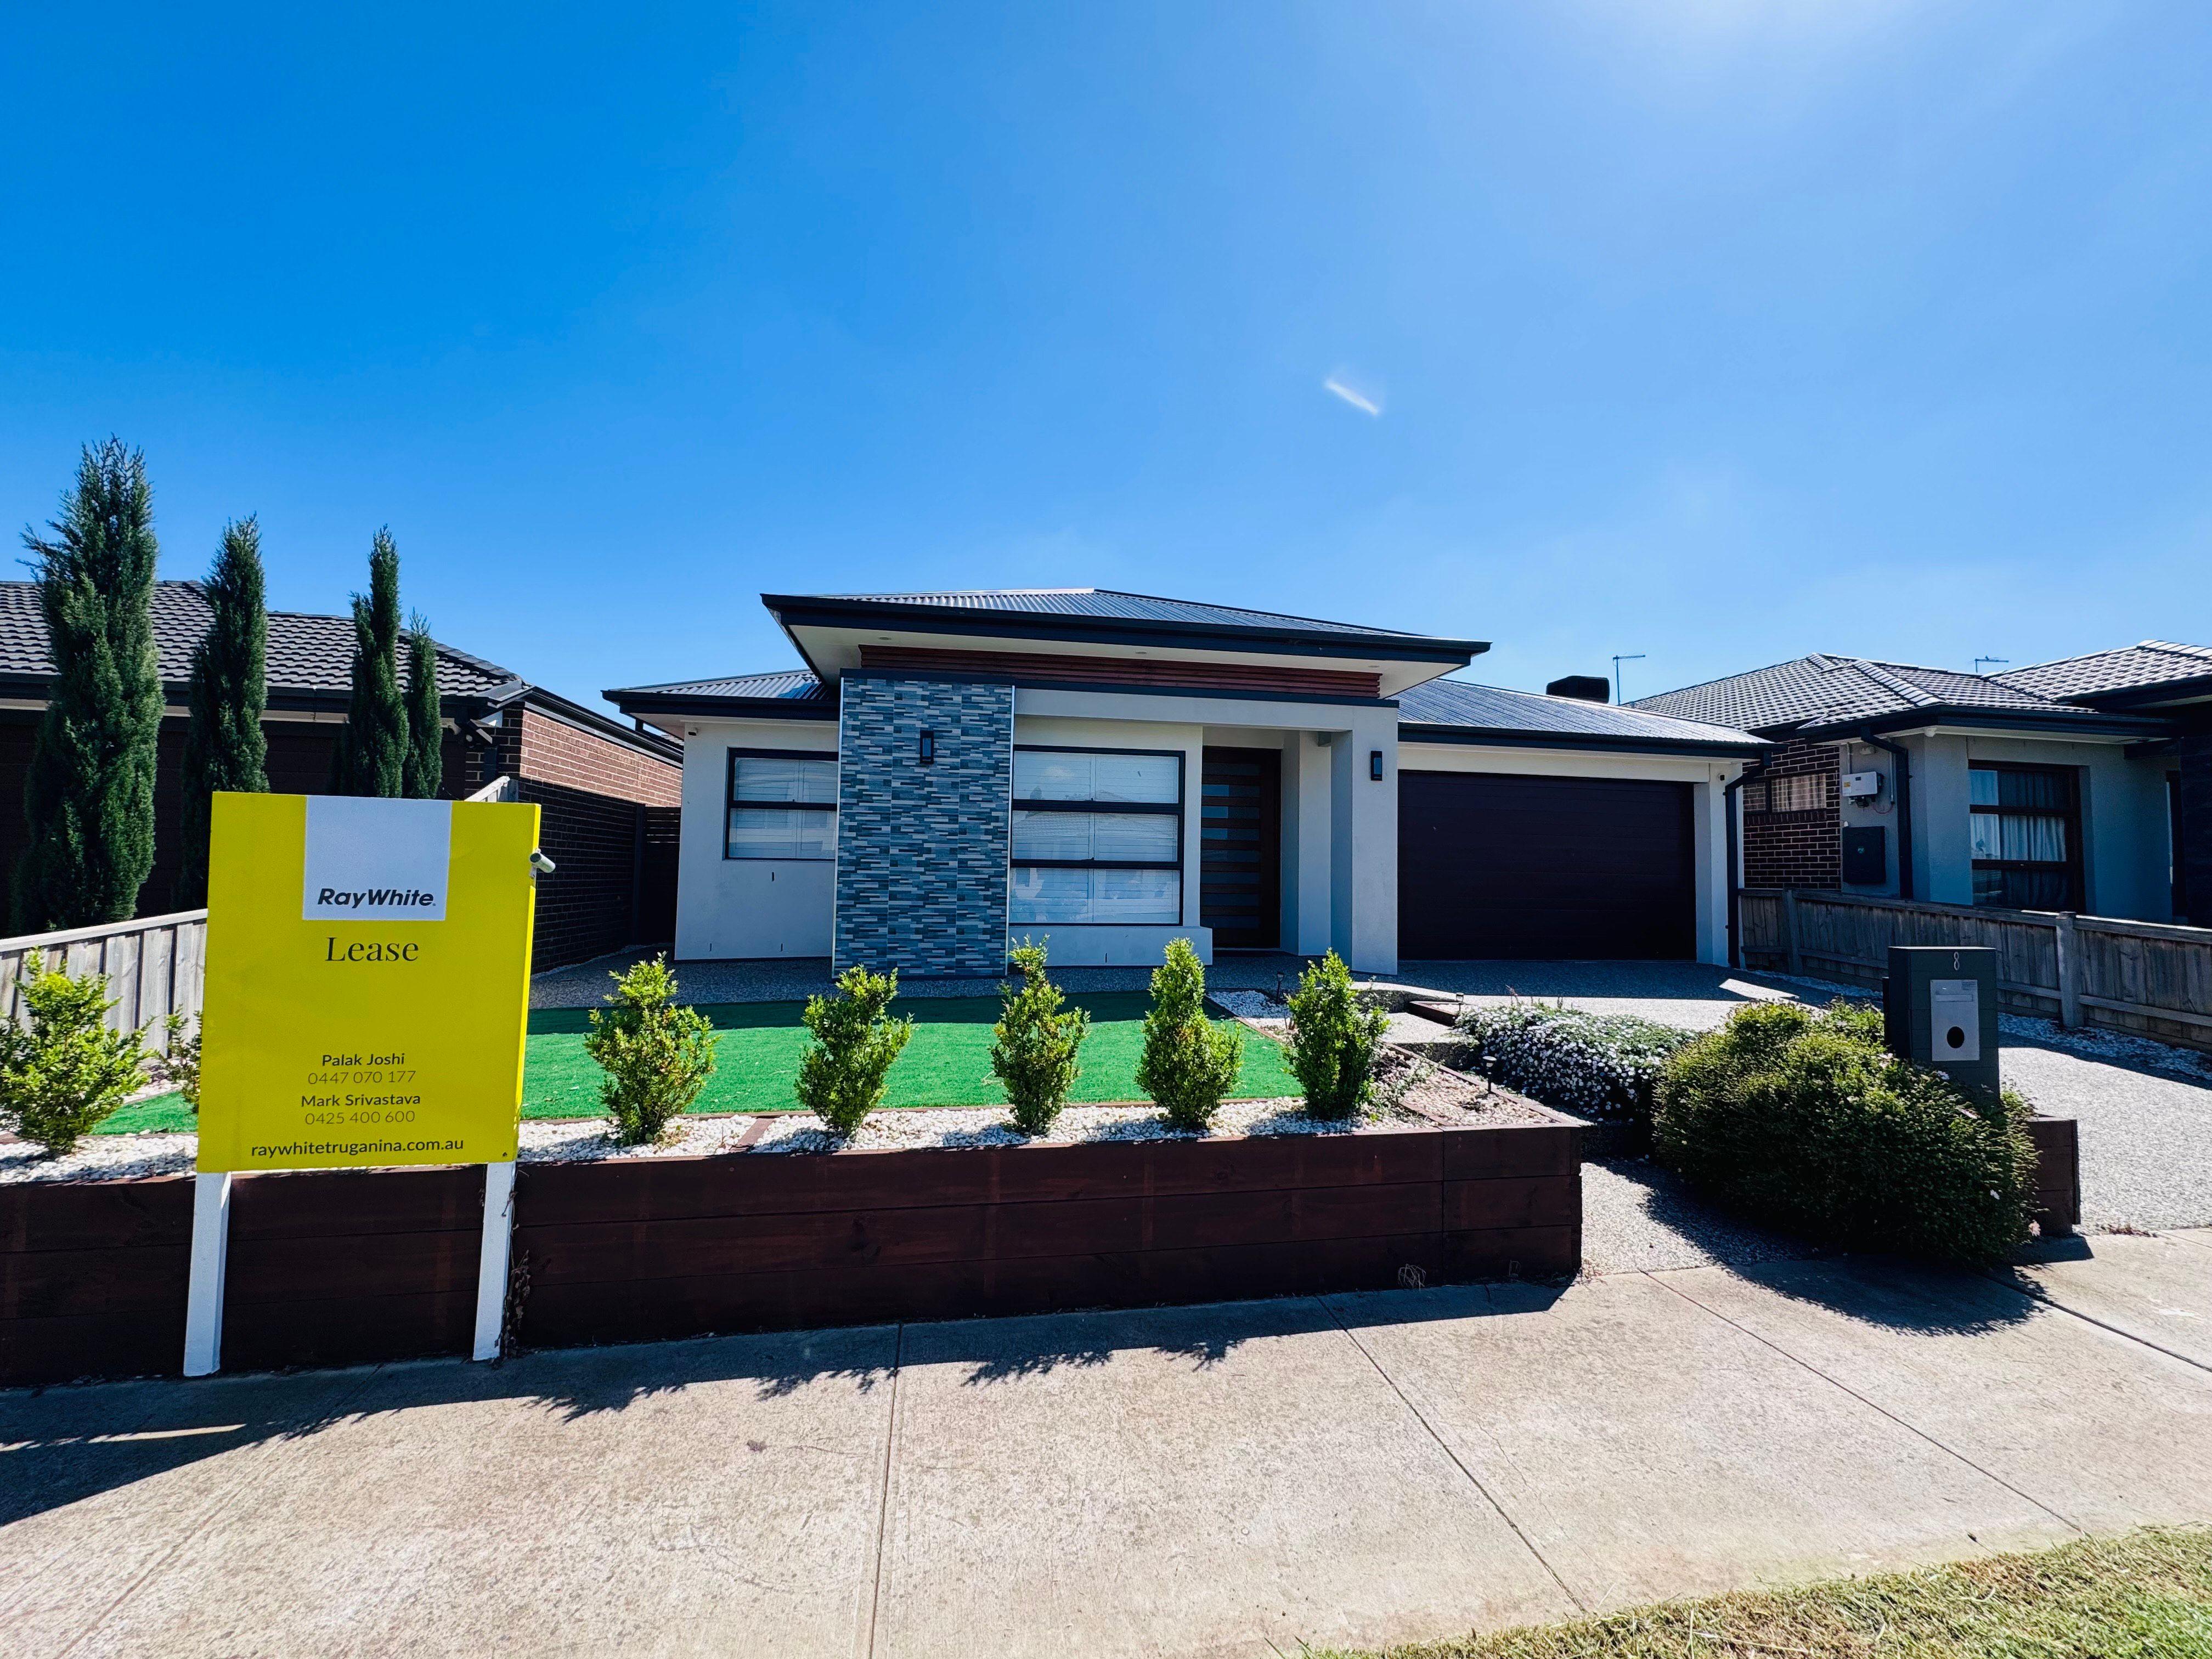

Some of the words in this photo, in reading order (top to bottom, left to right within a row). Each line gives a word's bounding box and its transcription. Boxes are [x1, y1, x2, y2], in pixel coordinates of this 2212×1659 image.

[325, 936, 419, 962] Lease
[1954, 951, 1960, 970] 8
[322, 1053, 362, 1066] Palak
[366, 1053, 405, 1065] Joshi
[308, 1071, 349, 1085] 0447
[353, 1071, 383, 1084] 070
[388, 1070, 416, 1083] 177
[301, 1094, 340, 1107] Mark
[345, 1093, 421, 1106] Srivastava
[305, 1112, 345, 1125] 0425
[349, 1111, 381, 1124] 400
[385, 1110, 415, 1123] 600
[251, 1139, 464, 1159] raywhitetruganina.com.au
